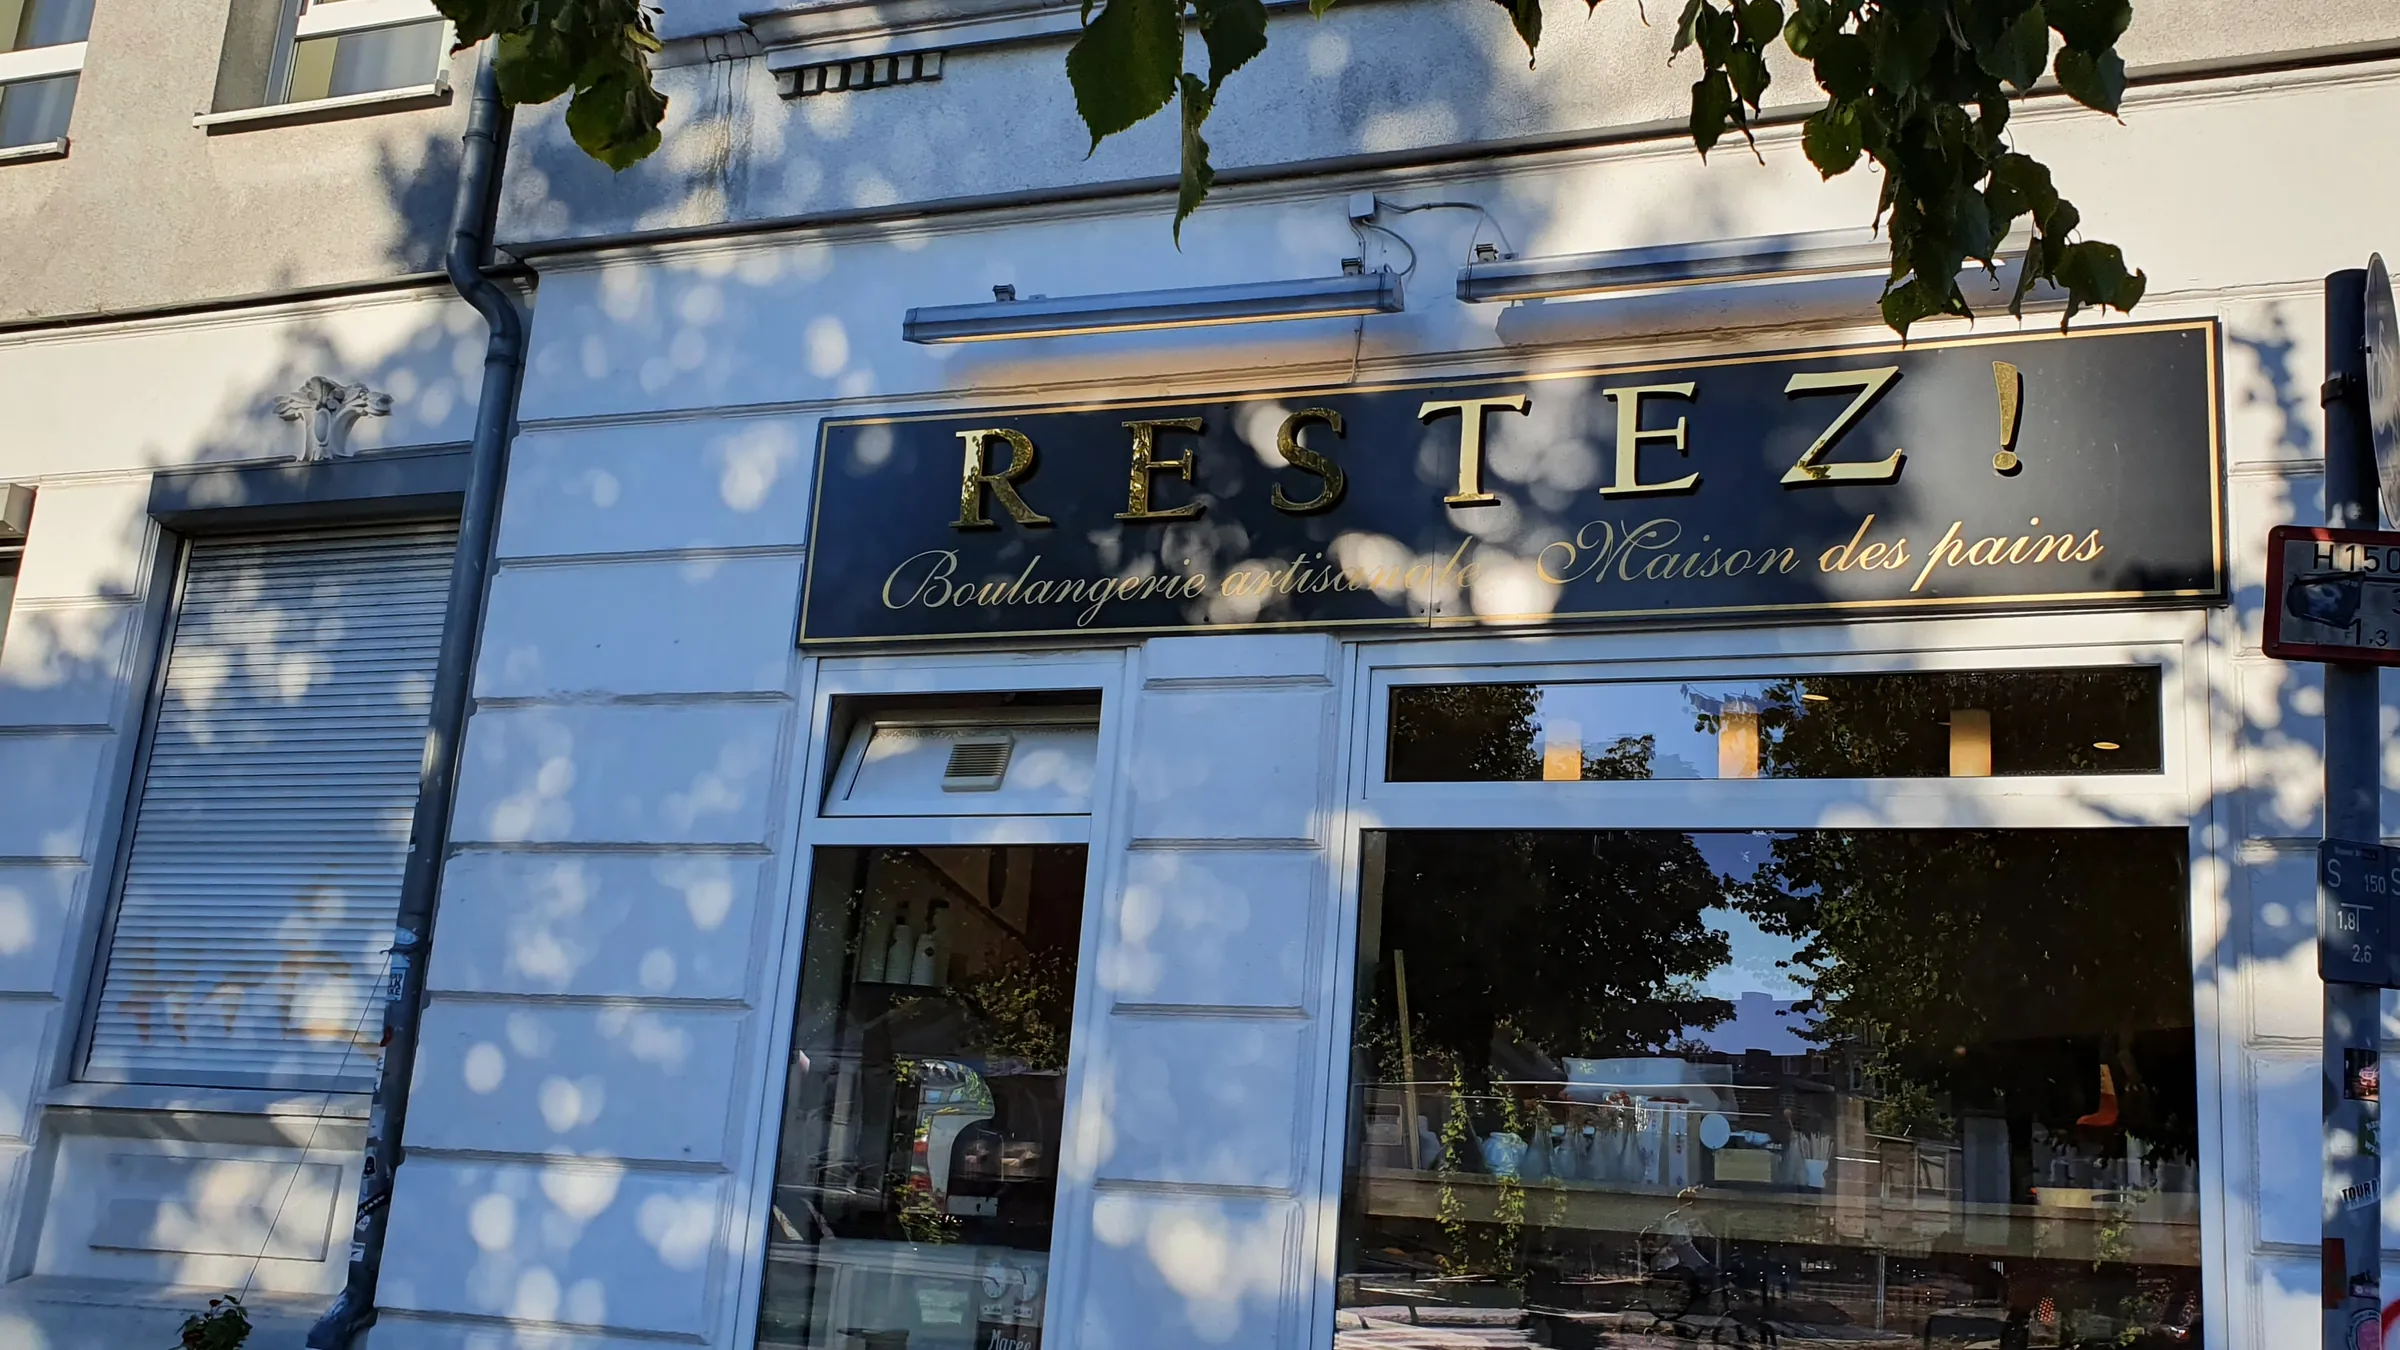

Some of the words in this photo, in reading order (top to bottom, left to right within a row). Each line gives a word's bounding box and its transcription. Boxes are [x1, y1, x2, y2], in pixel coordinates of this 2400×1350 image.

[882, 549, 1206, 627] Boulangerie
[1220, 535, 1482, 597] artisanale
[1537, 518, 1800, 585] Maison
[1818, 514, 1911, 572] des
[1910, 515, 2103, 592] pains
[2327, 858, 2341, 888] S
[2364, 873, 2386, 894] 150
